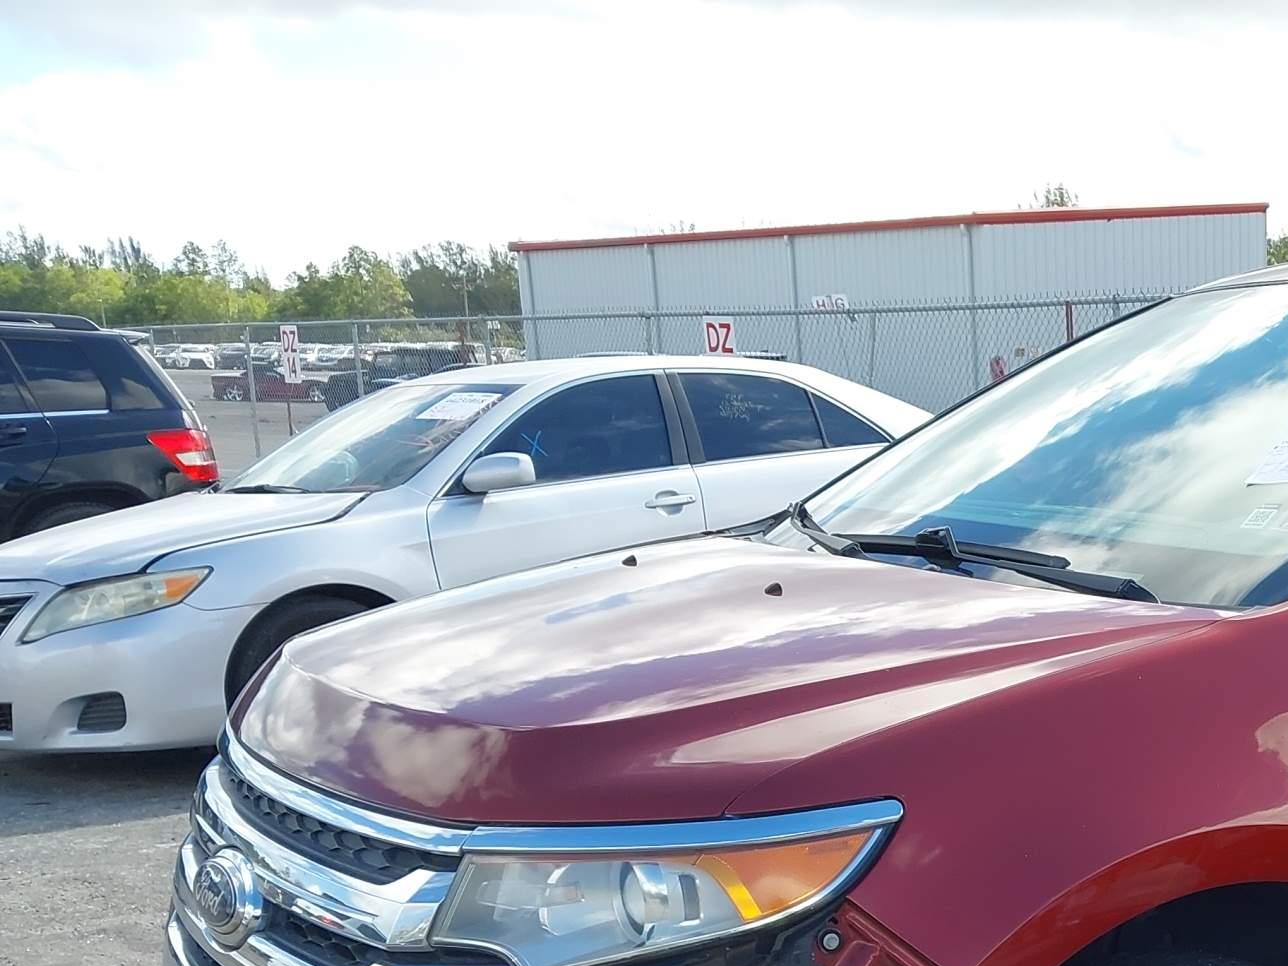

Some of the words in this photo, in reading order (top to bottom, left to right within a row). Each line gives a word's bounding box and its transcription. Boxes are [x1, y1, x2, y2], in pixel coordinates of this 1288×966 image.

[282, 330, 297, 353] DZ
[705, 322, 734, 354] DZ
[287, 356, 297, 378] 14
[195, 867, 225, 916] Ford
